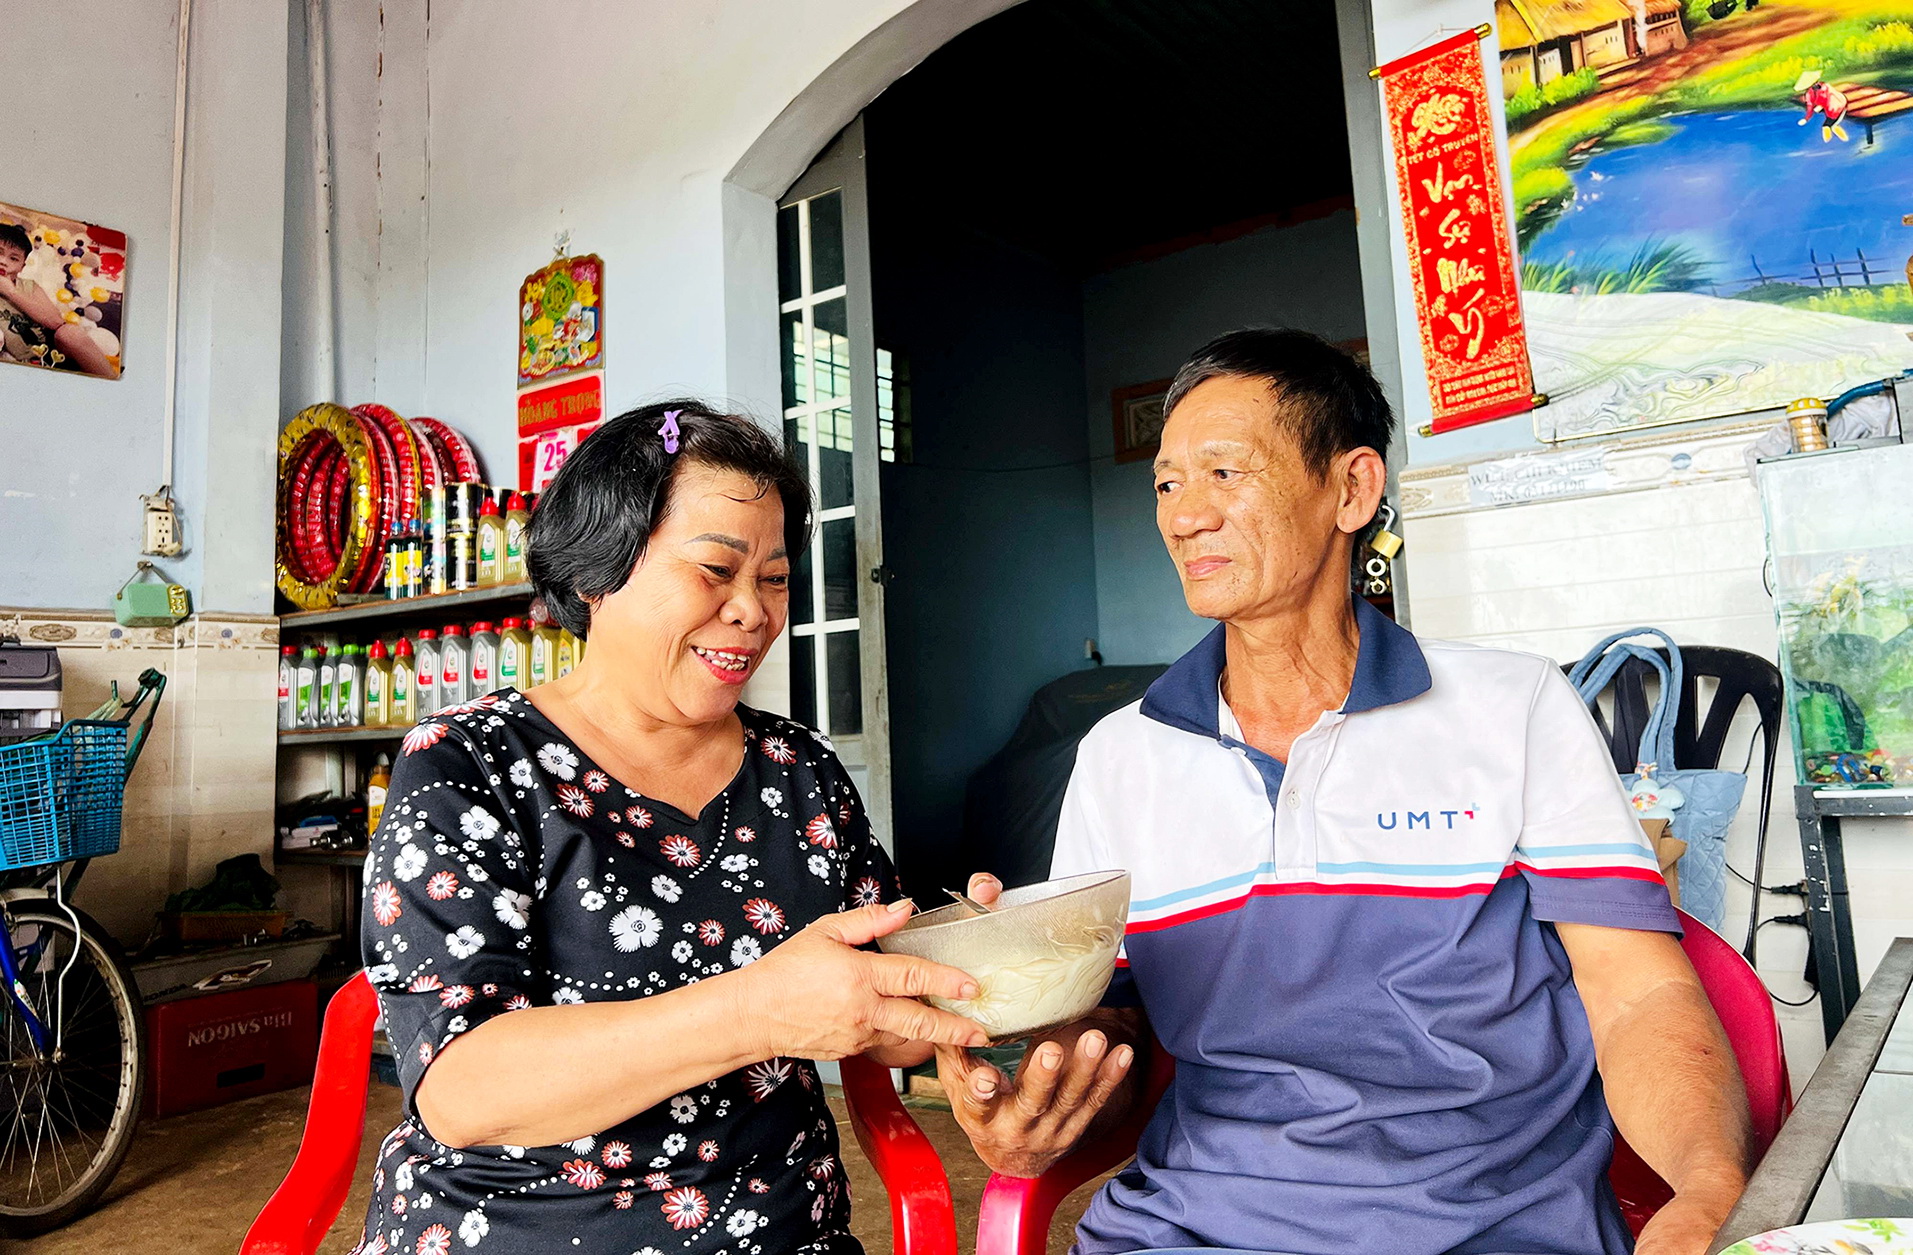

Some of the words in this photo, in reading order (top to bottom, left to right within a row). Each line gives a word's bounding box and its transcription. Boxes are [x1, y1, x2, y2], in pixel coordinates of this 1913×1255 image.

[544, 441, 567, 471] 25
[1378, 811, 1458, 830] UMT
[188, 1018, 261, 1047] SAIGON
